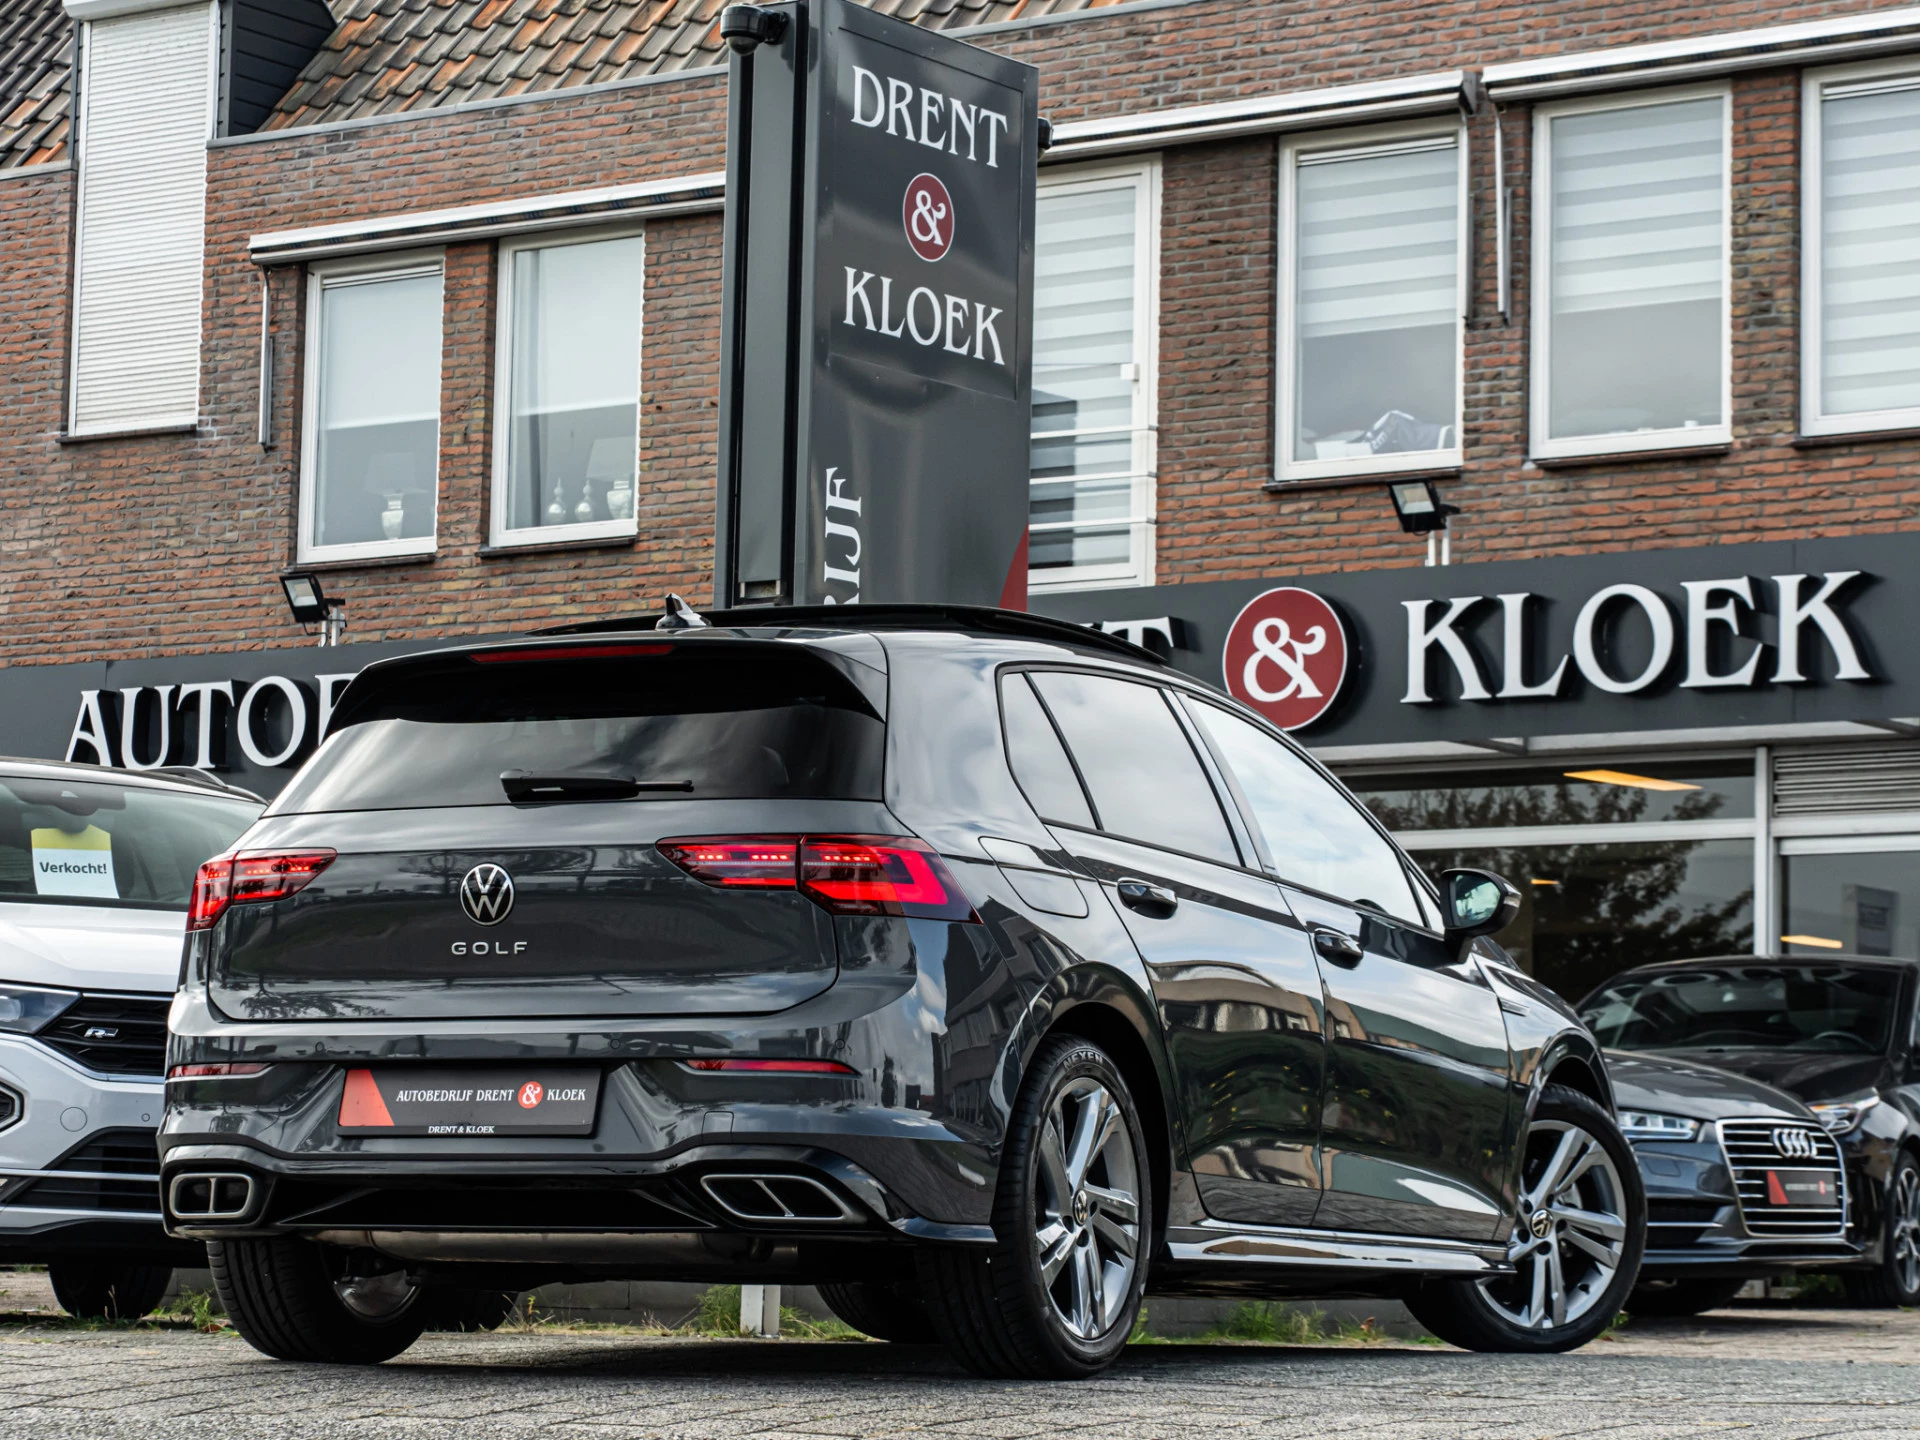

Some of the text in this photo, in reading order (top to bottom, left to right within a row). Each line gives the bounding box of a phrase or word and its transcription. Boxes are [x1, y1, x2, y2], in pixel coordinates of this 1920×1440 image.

[850, 65, 1008, 169] DRENT
[911, 189, 946, 247] &
[842, 265, 1005, 366] KLOEK
[1243, 617, 1327, 701] &
[1400, 570, 1872, 704] KLOEK
[39, 861, 108, 875] Verkocht!
[451, 941, 528, 955] GOLF
[1062, 1051, 1103, 1070] NEXEN
[396, 1084, 587, 1105] AUTOBEDRIJF DRENT & KLOEK
[427, 1125, 495, 1135] DRENT & KLOEK
